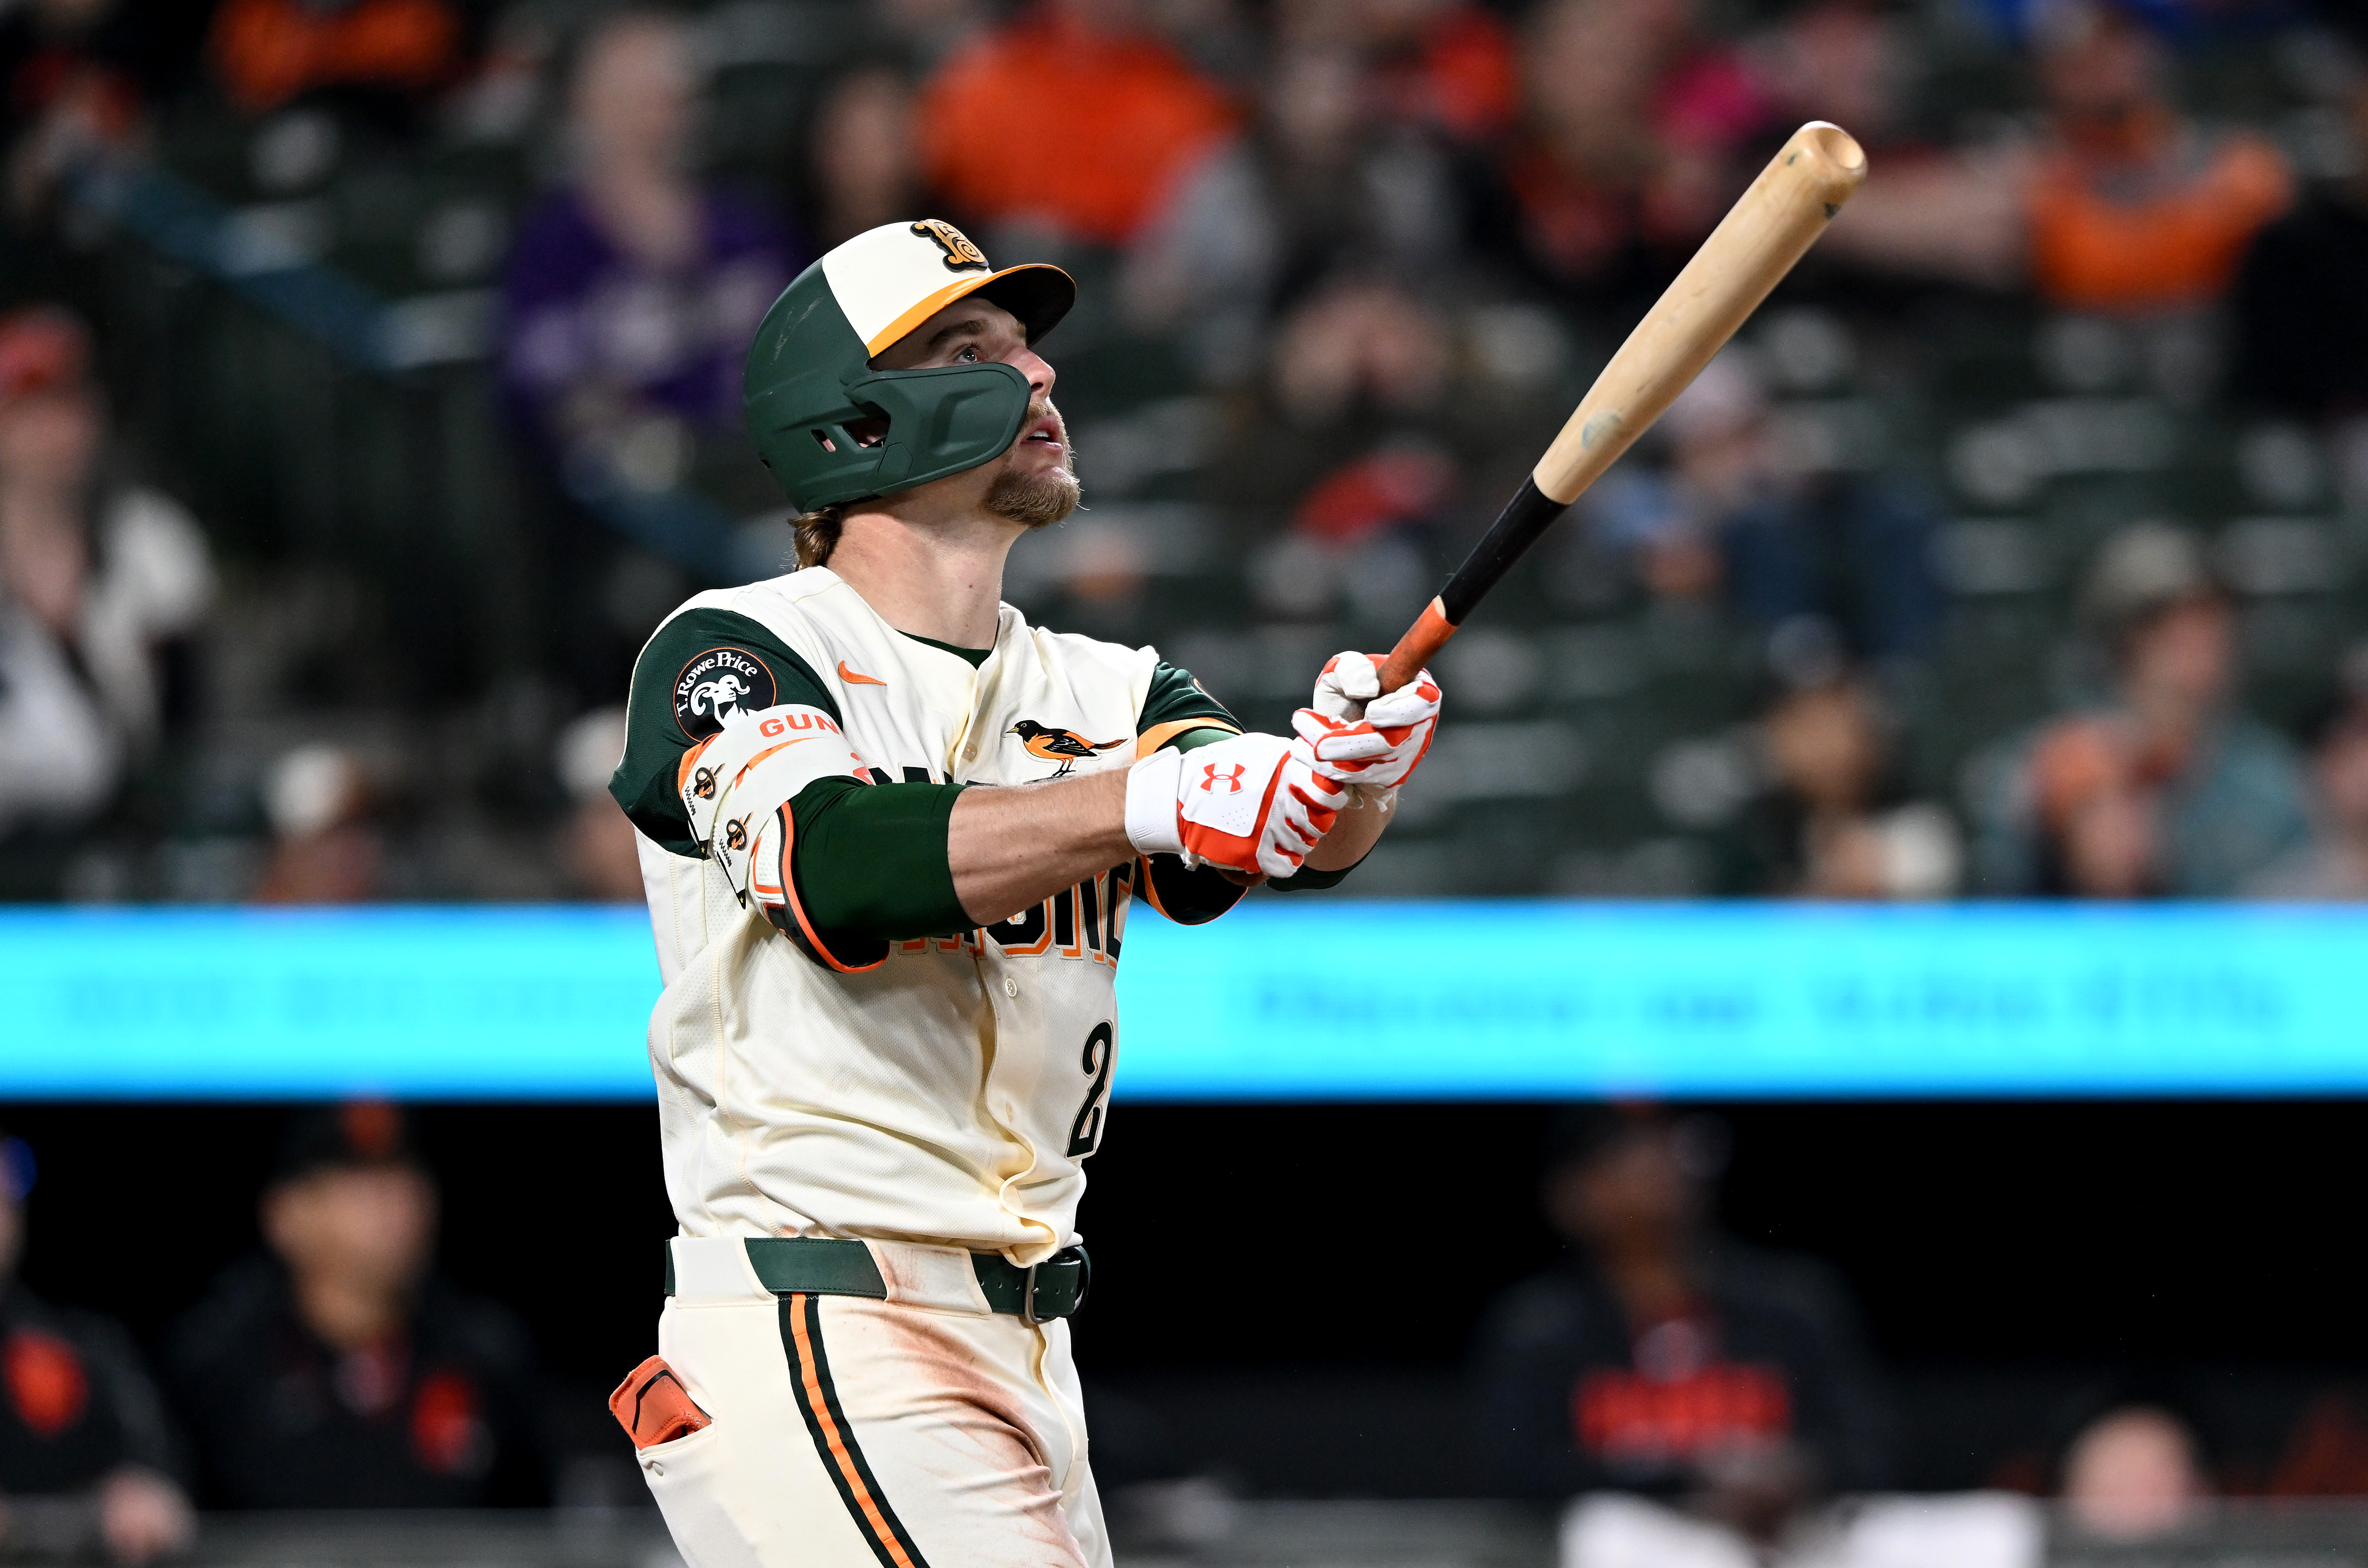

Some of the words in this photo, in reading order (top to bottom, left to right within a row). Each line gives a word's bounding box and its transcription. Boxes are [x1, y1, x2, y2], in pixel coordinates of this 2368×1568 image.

[677, 658, 715, 697] Rowe
[716, 651, 758, 677] Price
[759, 714, 848, 741] GUN
